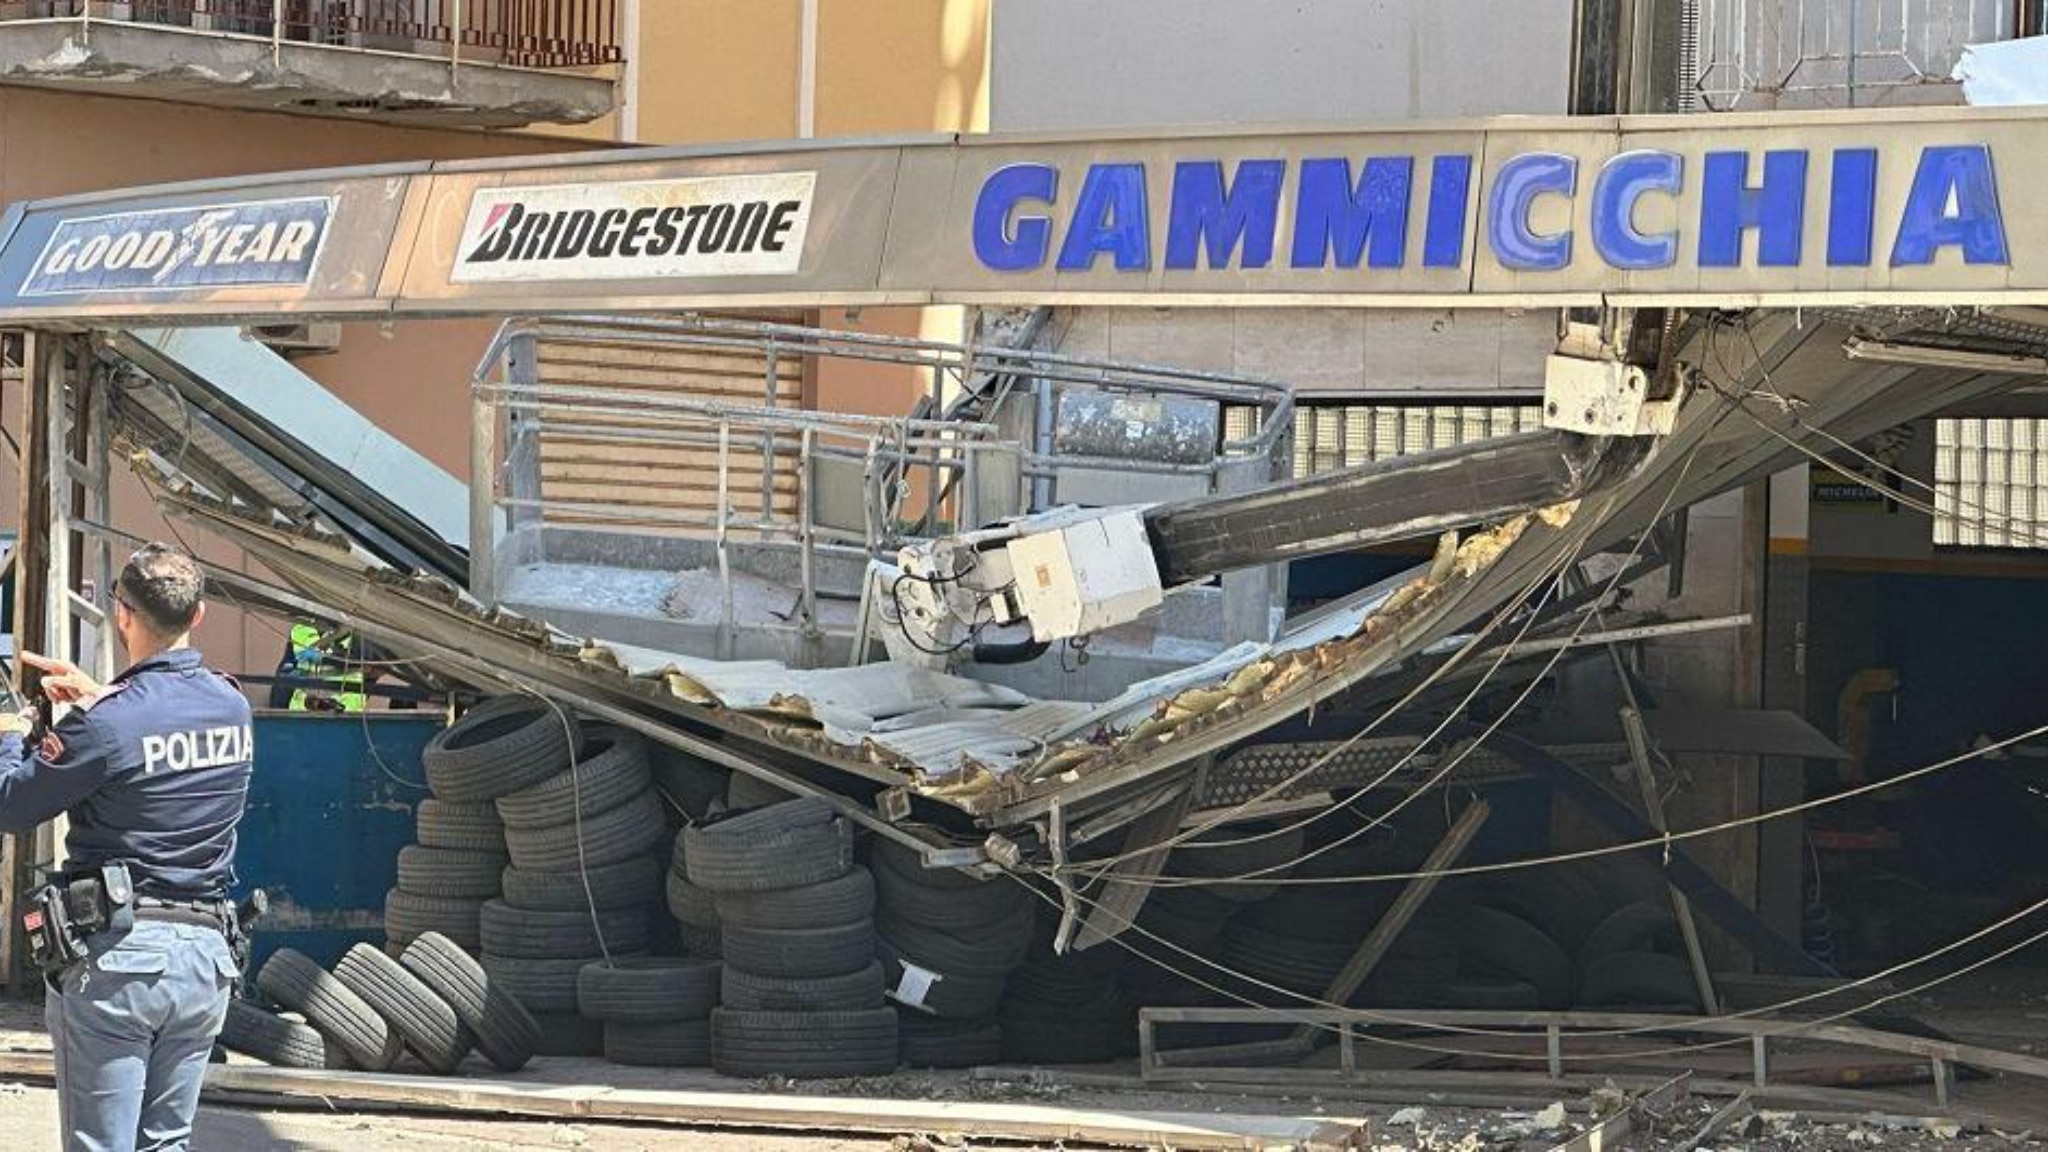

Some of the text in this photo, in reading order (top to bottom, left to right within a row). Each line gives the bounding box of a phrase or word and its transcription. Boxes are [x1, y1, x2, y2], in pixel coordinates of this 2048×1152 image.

[465, 200, 801, 263] BRIDGESTONE
[973, 144, 2009, 273] GAMMICCHIA
[142, 724, 253, 774] POLIZIA
